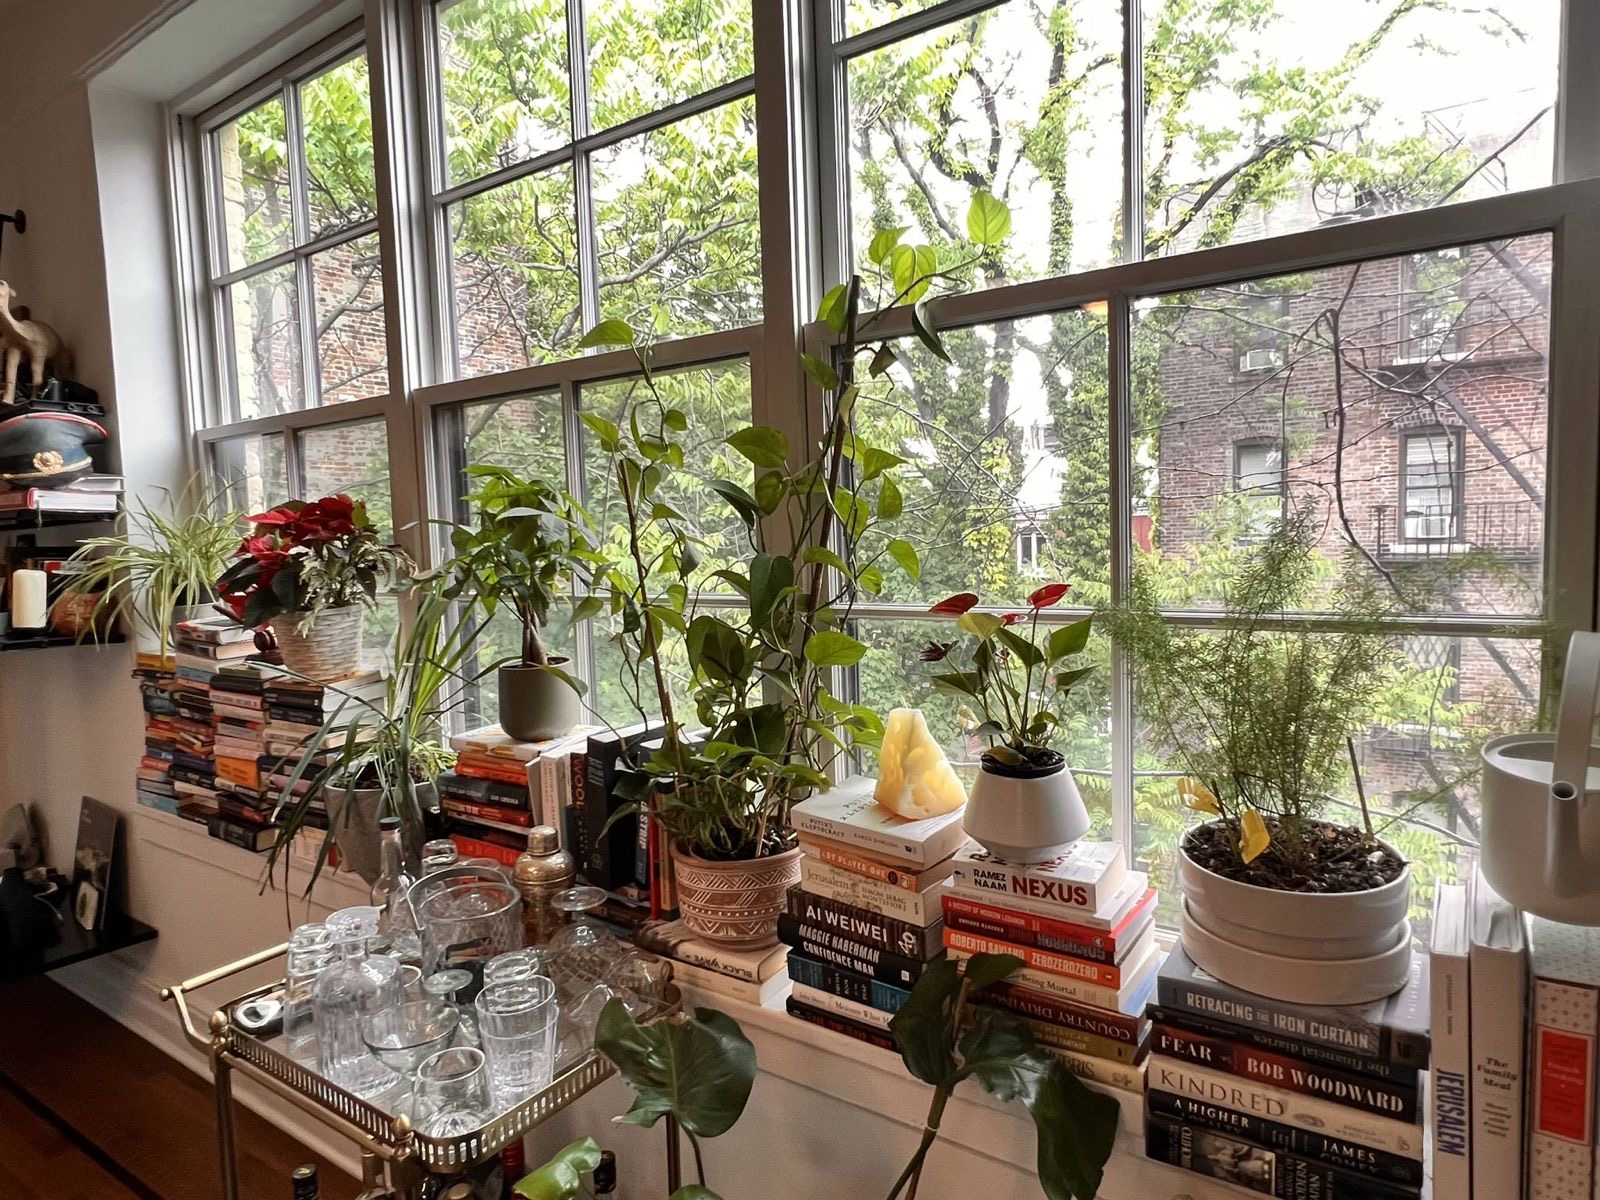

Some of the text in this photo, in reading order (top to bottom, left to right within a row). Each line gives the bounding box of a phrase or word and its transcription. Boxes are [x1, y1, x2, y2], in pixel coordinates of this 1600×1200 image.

[572, 756, 585, 809] WOOL
[639, 815, 648, 850] STRIP
[807, 868, 850, 890] Jerusalem
[840, 854, 867, 872] PLAYER
[870, 866, 886, 878] ONE
[973, 868, 1006, 882] RAMEZ
[974, 878, 1007, 892] NAAM
[1012, 875, 1087, 906] NEXUS
[806, 905, 887, 942] AI WEIWEI
[799, 924, 880, 964] MAGGIE HABERMAN
[803, 941, 875, 976] CONFIDENCE MAN
[950, 933, 987, 952] ROBERTO
[1031, 952, 1098, 980] ZEROZEROZERO
[695, 955, 721, 969] WAVE
[722, 963, 752, 978] BLACK
[1022, 974, 1077, 996] Being Mortal
[1058, 1011, 1130, 1041] COUNTRY
[1187, 993, 1253, 1021] RETRACING
[1274, 1013, 1306, 1034] IRON
[1310, 1022, 1368, 1049] CURTAIN
[1254, 1035, 1390, 1077] the financial diaries
[1485, 1057, 1508, 1069] The
[1161, 1035, 1403, 1112] FEAR BOB WOODWARD
[1477, 1064, 1518, 1081] Family
[1483, 1077, 1512, 1091] Meal
[1162, 1069, 1284, 1117] KINDRED
[1174, 1099, 1249, 1128] A HIGHER
[1436, 1068, 1465, 1157] JERUSALEM
[1322, 1140, 1376, 1164] JAMES
[1296, 1160, 1308, 1200] ODERN
